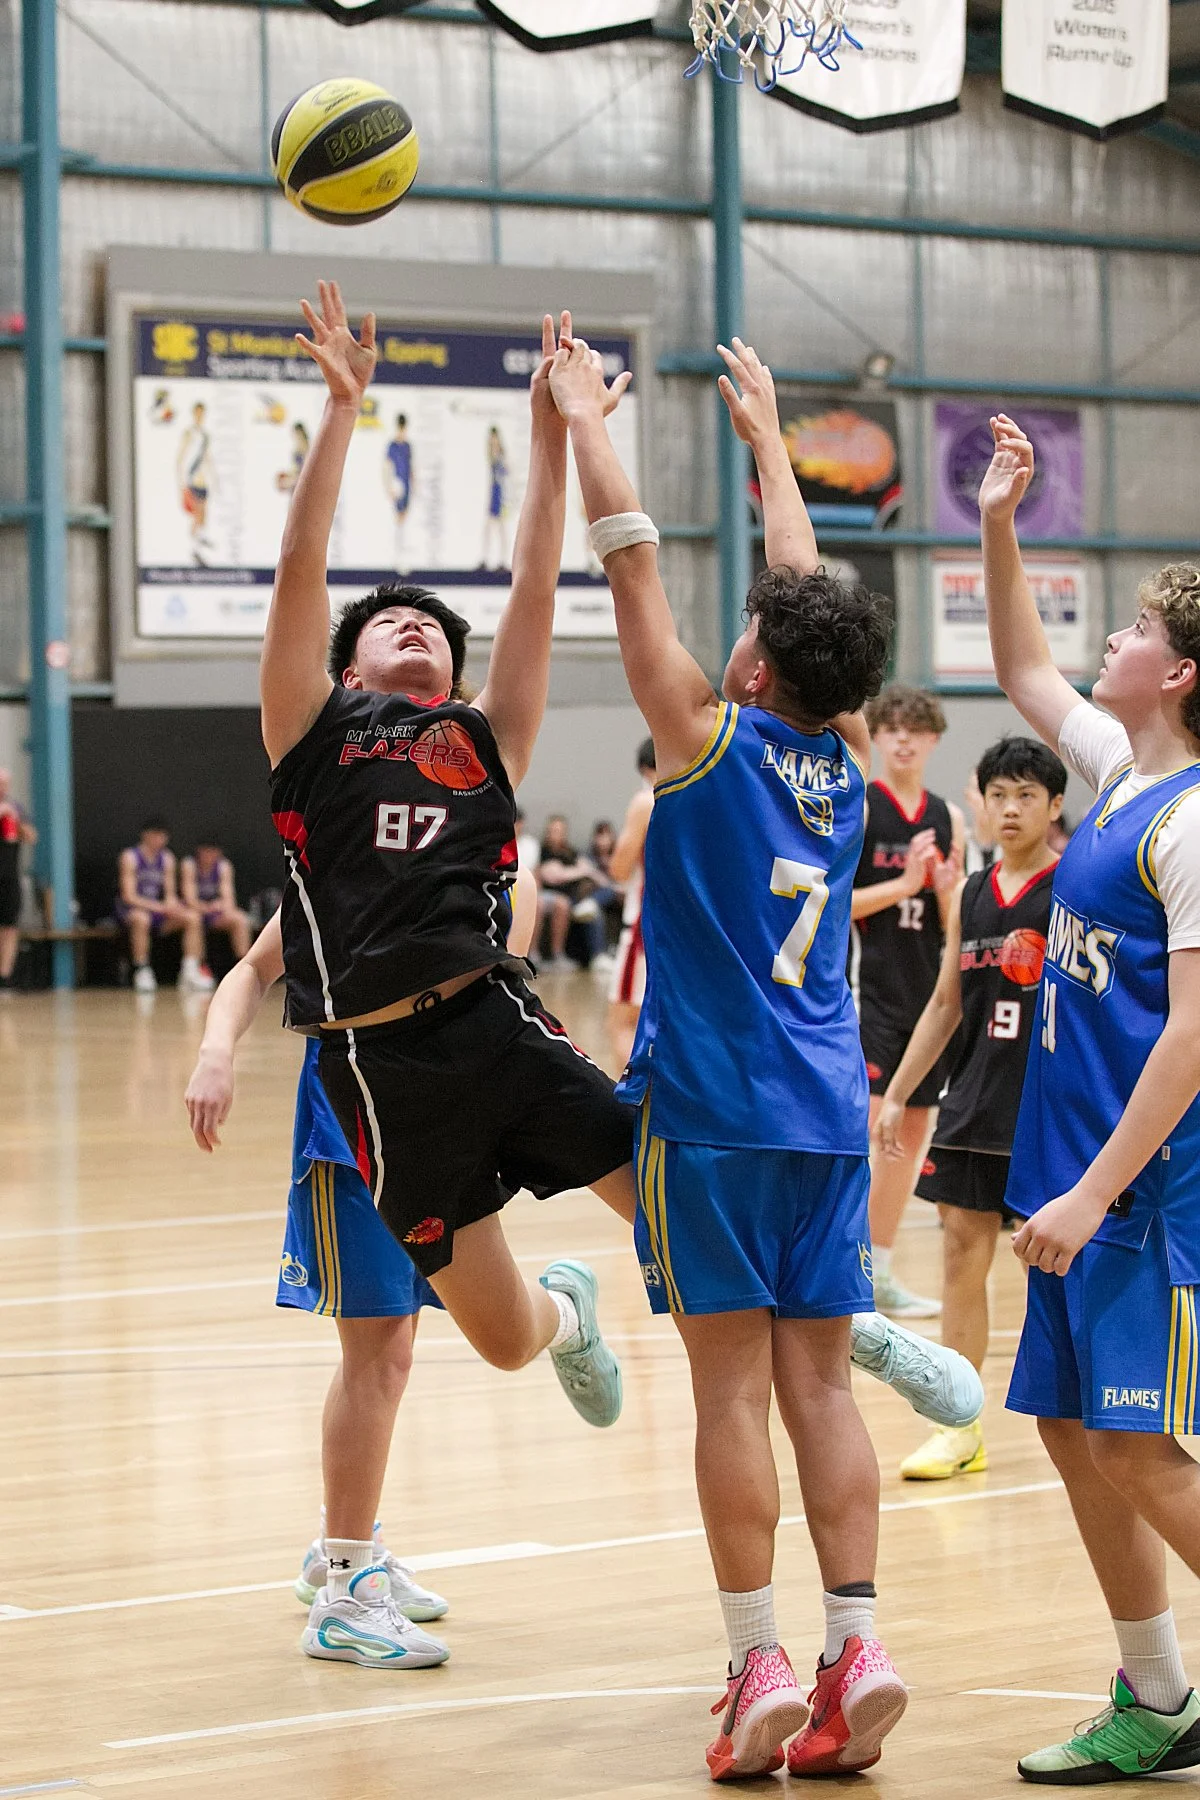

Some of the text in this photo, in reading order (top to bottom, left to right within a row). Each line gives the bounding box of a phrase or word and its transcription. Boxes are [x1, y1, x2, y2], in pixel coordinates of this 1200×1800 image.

[374, 724, 418, 738] PARK
[374, 802, 448, 851] 87
[770, 857, 829, 988] 7
[987, 1000, 1021, 1040] 9
[1102, 1386, 1161, 1411] FLAMES
